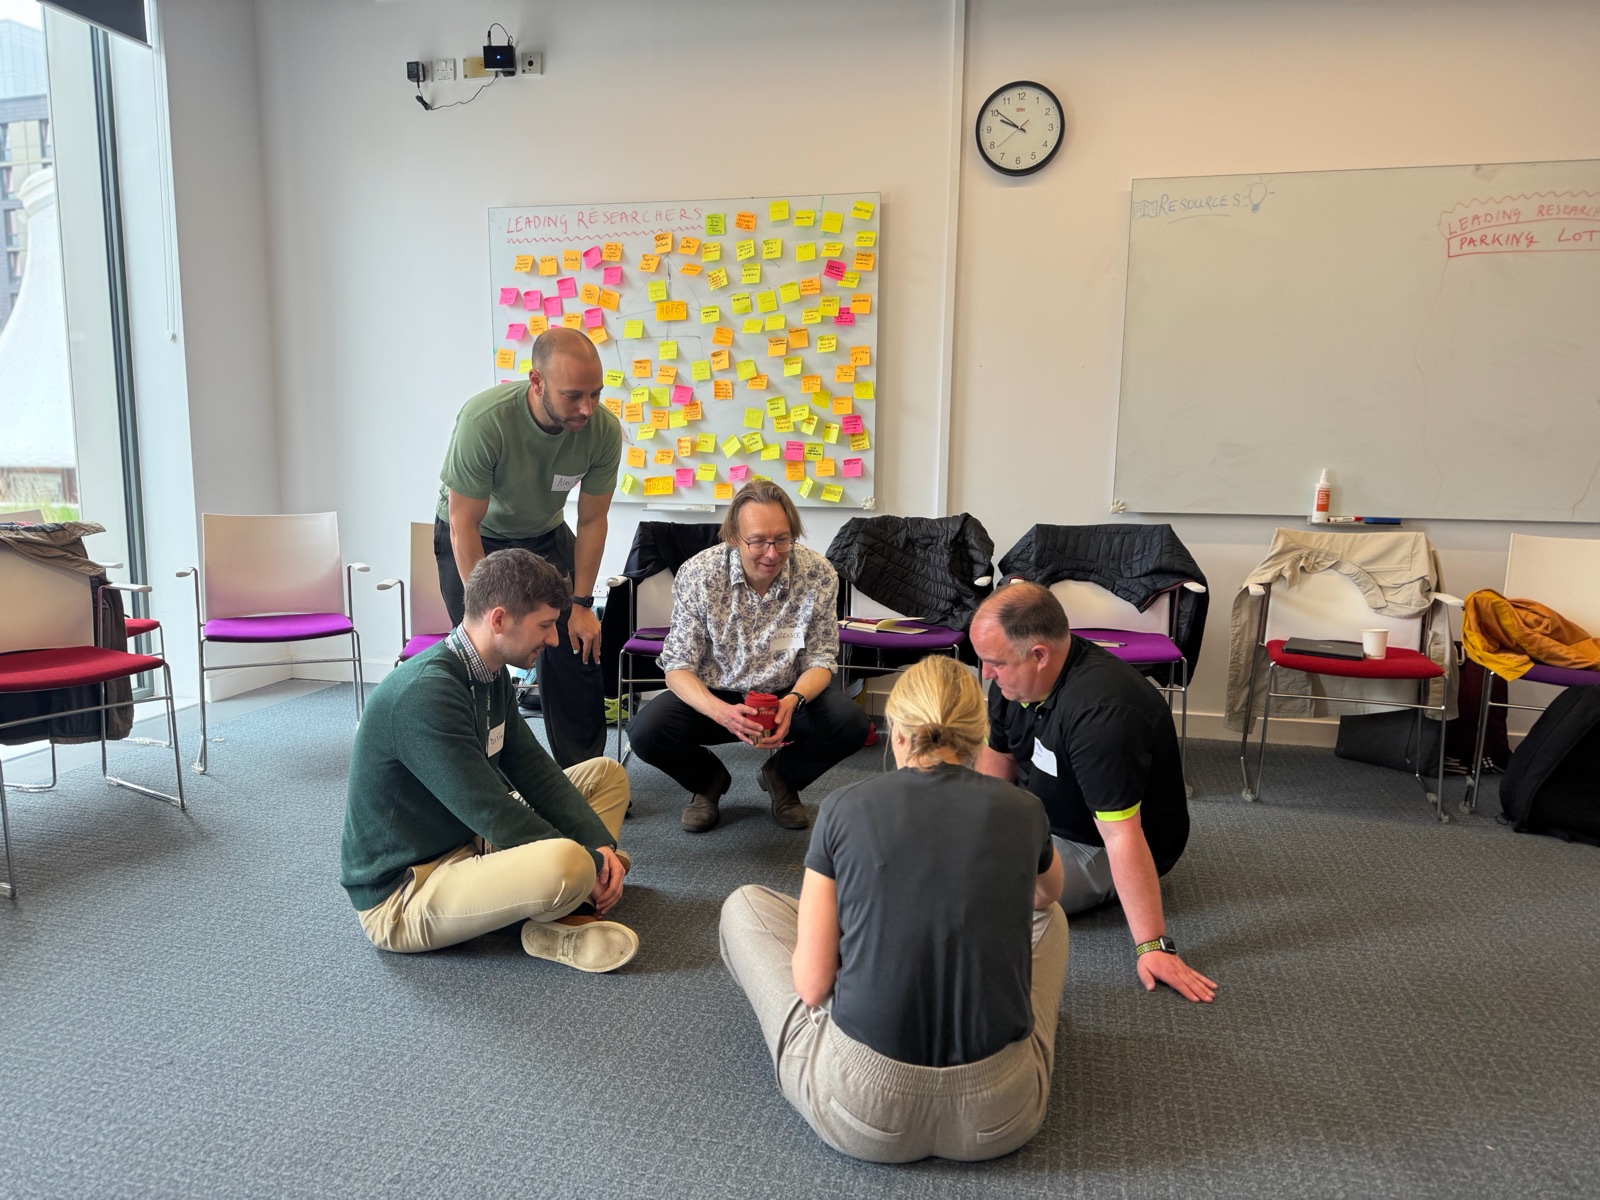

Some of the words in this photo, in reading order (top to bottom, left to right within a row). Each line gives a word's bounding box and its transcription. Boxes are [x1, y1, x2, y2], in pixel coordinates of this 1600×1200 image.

[1017, 92, 1026, 100] 12
[1035, 96, 1040, 104] 1
[1002, 97, 1011, 105] 11
[990, 109, 999, 117] 10
[1044, 107, 1051, 116] 2
[986, 125, 992, 134] 9
[1048, 123, 1054, 132] 3
[989, 141, 995, 149] 8
[1042, 140, 1048, 148] 4
[1000, 152, 1005, 161] 7
[1030, 151, 1036, 160] 5
[1015, 156, 1021, 165] 6
[506, 214, 568, 235] LEADING
[577, 207, 703, 230] RESEARCHERS
[1448, 208, 1521, 236] LEADING
[1459, 231, 1540, 250] PARKING
[1558, 228, 1600, 242] LOT
[659, 302, 686, 316] HOPES
[645, 479, 672, 492] HOLDS
